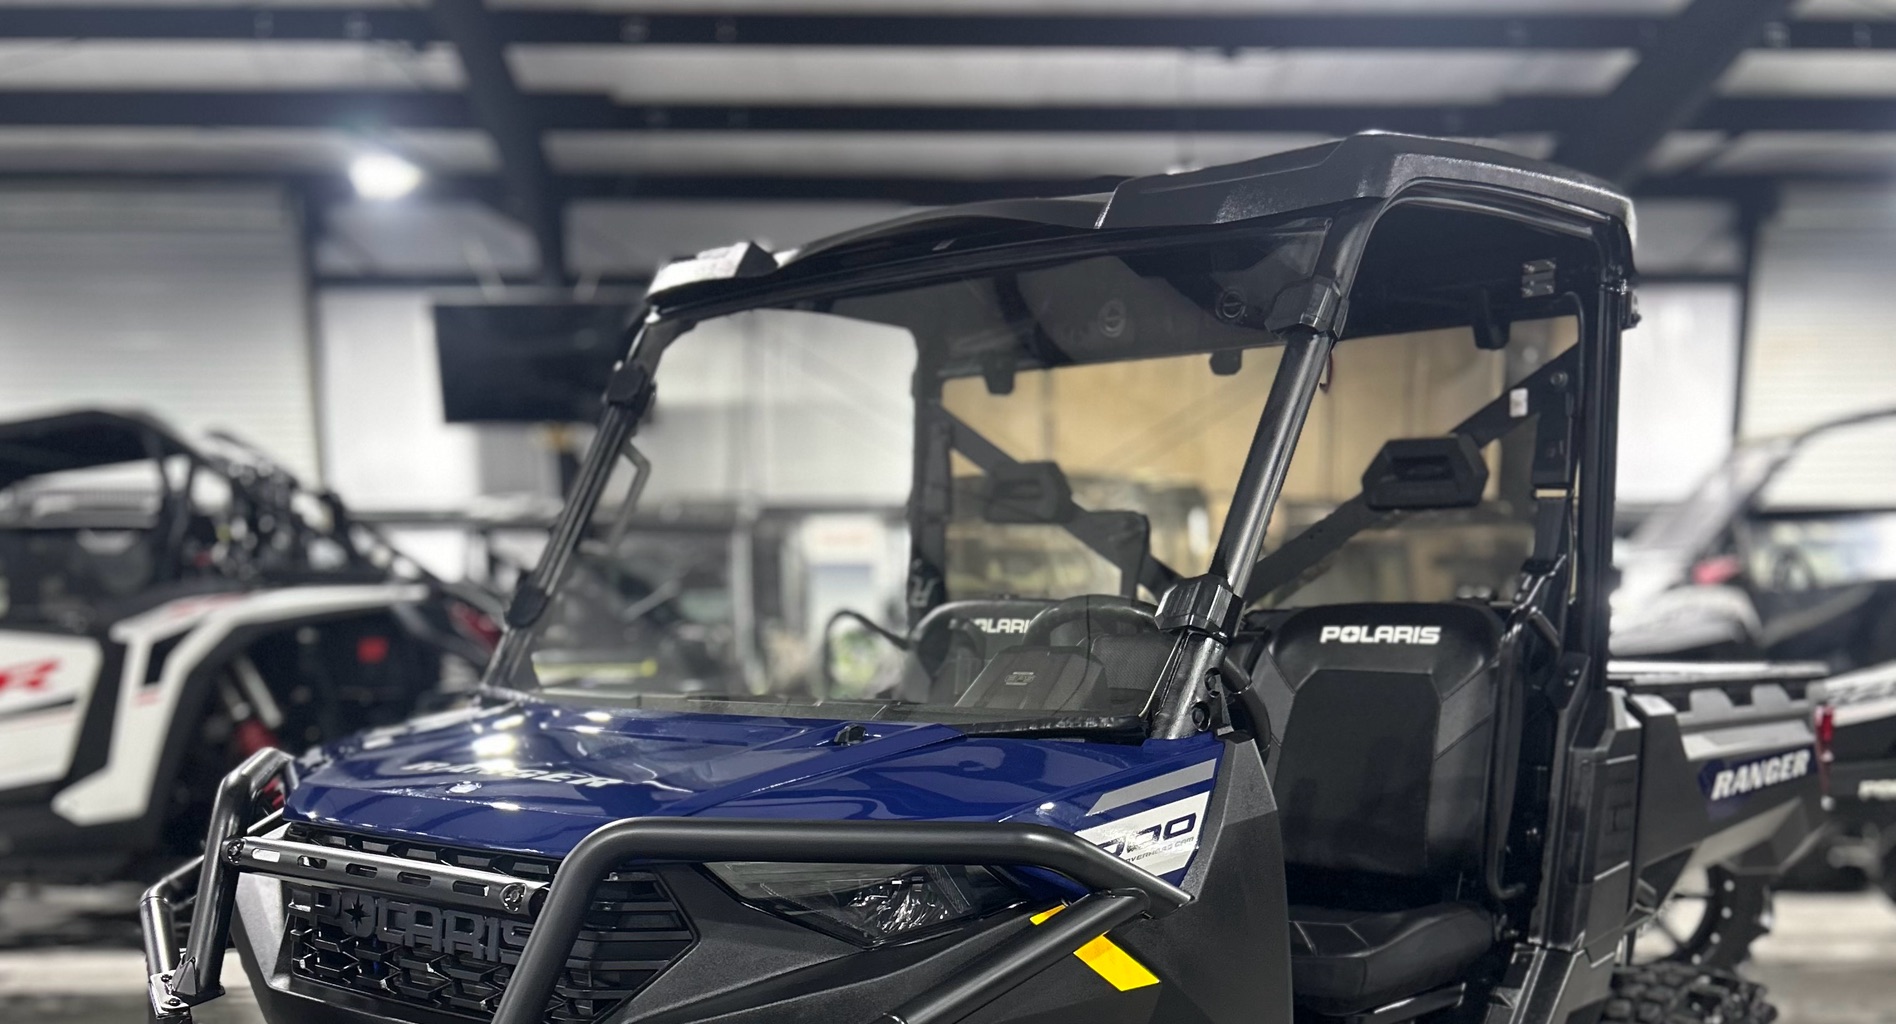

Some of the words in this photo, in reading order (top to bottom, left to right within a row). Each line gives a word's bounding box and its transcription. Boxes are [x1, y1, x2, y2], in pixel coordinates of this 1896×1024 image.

[1319, 625, 1441, 645] POLARIS
[1711, 749, 1810, 801] RANGER
[312, 884, 536, 965] POLARIS
